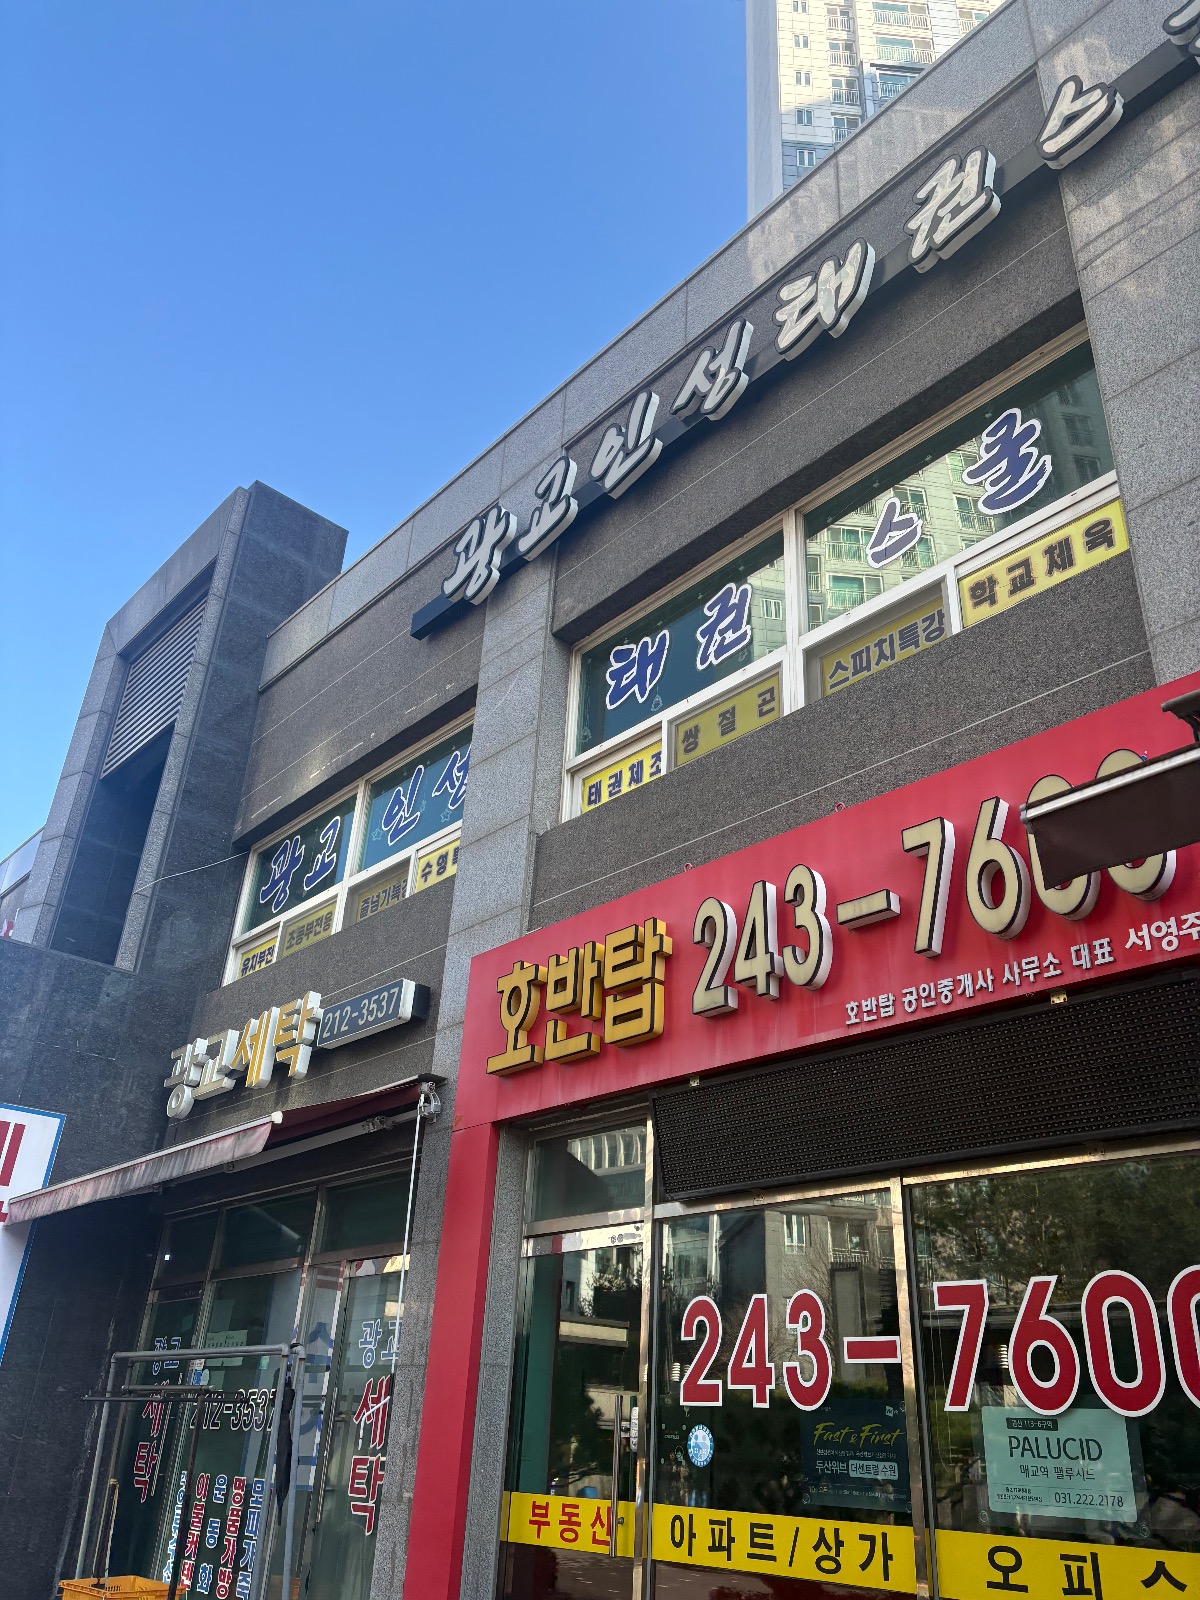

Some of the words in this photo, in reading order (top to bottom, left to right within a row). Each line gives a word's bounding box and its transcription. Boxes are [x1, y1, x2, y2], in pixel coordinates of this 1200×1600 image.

[829, 609, 944, 690] 스피치특강
[846, 993, 895, 1025] 호반탑
[901, 968, 994, 1012] 공인중개사
[1003, 952, 1063, 985] 사무소
[1071, 938, 1115, 970] 대표
[1125, 911, 1200, 951] 서영주
[322, 986, 400, 1039] 212-3537
[486, 917, 673, 1077] 호반탑
[164, 990, 321, 1119] 광교세탁
[813, 1422, 855, 1446] Fast
[860, 1424, 905, 1447] First
[1008, 1435, 1103, 1461] PALUCID
[815, 1460, 847, 1475] 두산위브
[881, 1464, 897, 1477] 수원
[1020, 1464, 1049, 1479] 매교역
[1054, 1466, 1095, 1481] 팰루시드
[528, 1500, 611, 1546] 부동산
[1054, 1492, 1124, 1507] 031.222.2178
[197, 1474, 227, 1594] 운동화
[216, 1476, 246, 1599] 명품가방
